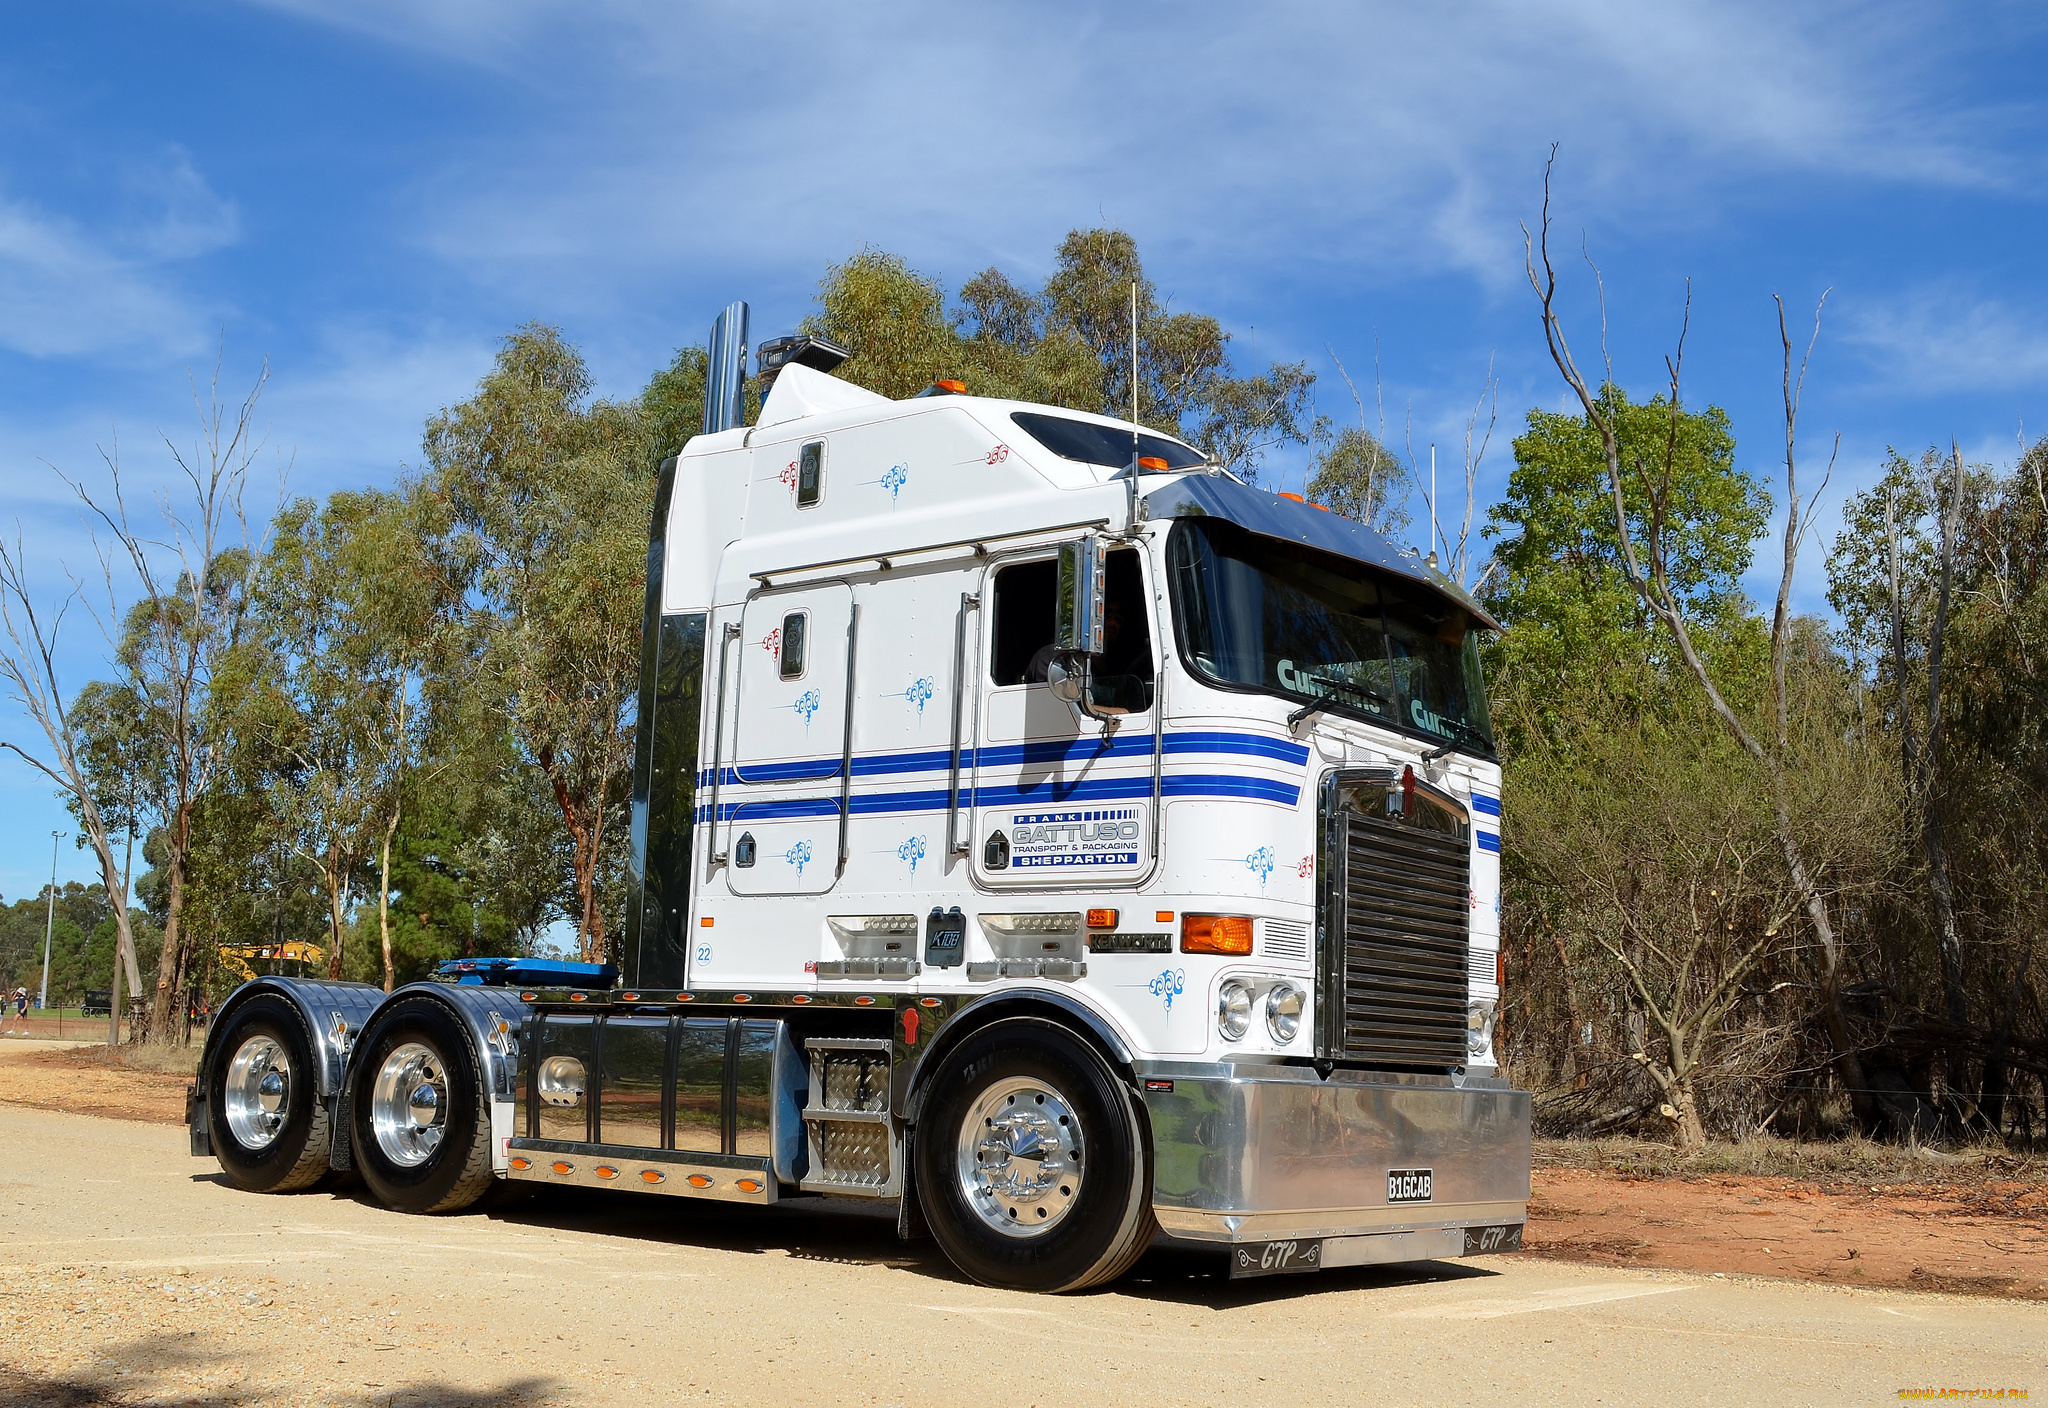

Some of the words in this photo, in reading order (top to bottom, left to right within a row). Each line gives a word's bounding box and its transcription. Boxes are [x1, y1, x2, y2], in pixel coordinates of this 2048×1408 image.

[1017, 814, 1076, 823] FRANK
[1012, 821, 1139, 844] GATTUSO
[1013, 844, 1069, 853] TRANSPORT
[1082, 842, 1138, 850] PACKAGING
[1021, 854, 1128, 866] SHEPPARTON
[1090, 934, 1173, 949] KENWORTH
[697, 947, 711, 961] 22
[1388, 1176, 1431, 1199] B1GCAB
[1480, 1227, 1507, 1250] GTP
[1260, 1241, 1298, 1270] GTP
